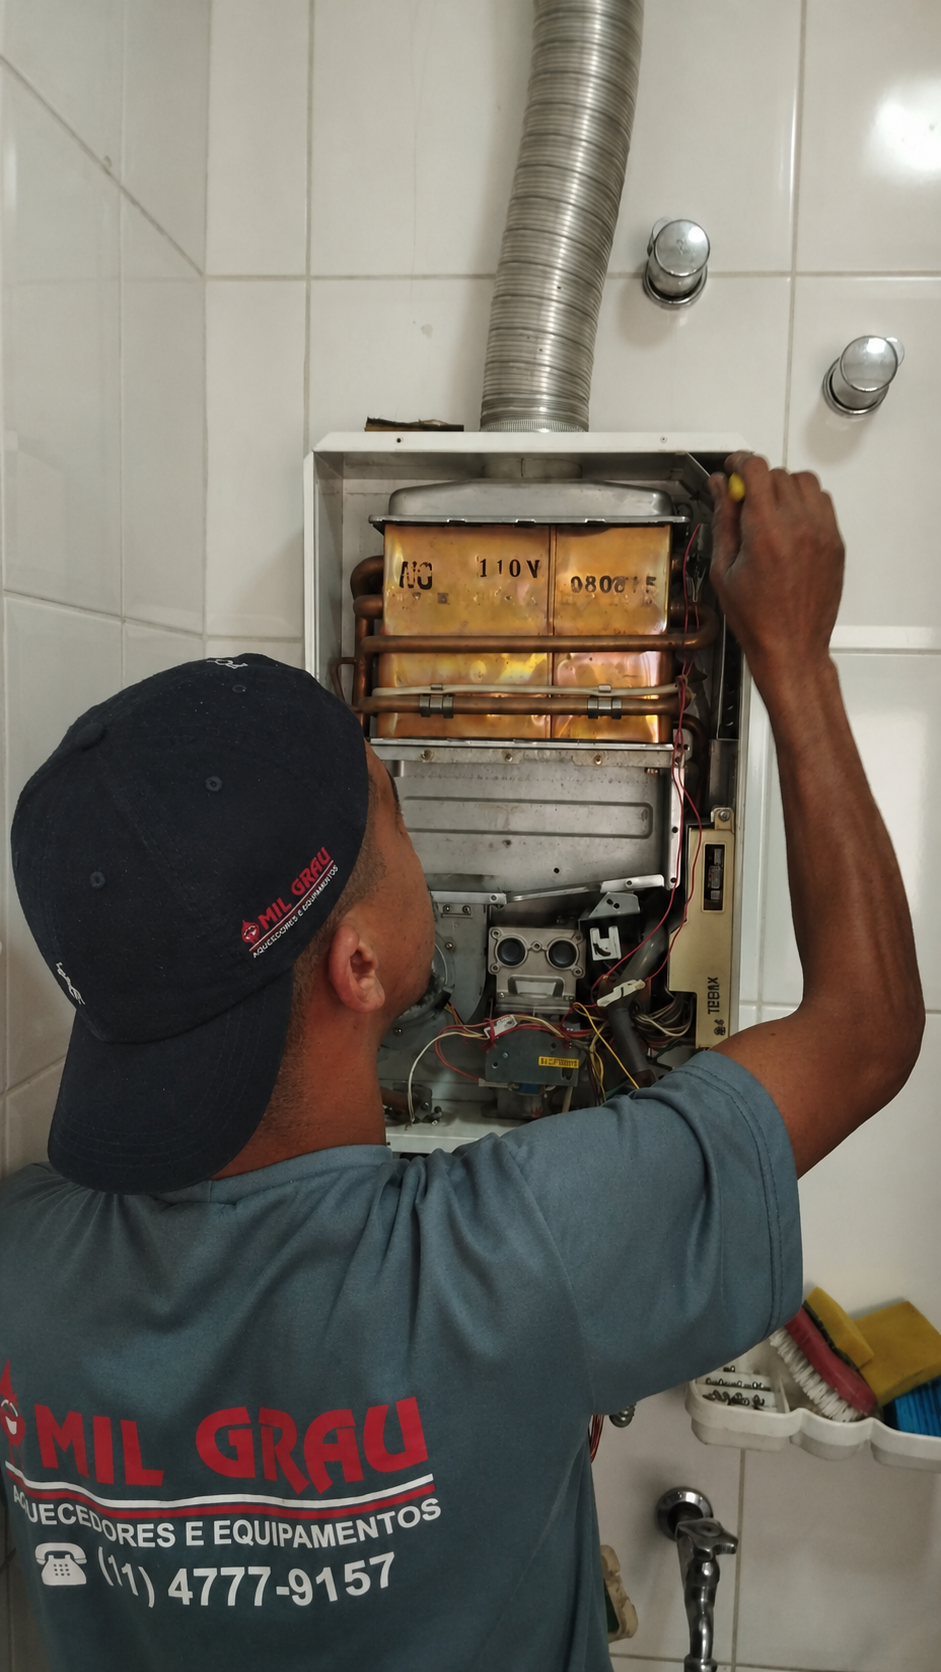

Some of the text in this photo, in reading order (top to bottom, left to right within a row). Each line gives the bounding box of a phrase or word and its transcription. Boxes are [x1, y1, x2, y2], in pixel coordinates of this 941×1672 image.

[258, 846, 331, 930] MIL GRAU
[34, 1396, 429, 1495] MIL GRAU
[13, 1484, 442, 1549] AQUECEDORES E EQUIPAMENTOS
[97, 1546, 396, 1609] (11) 4777-9157
